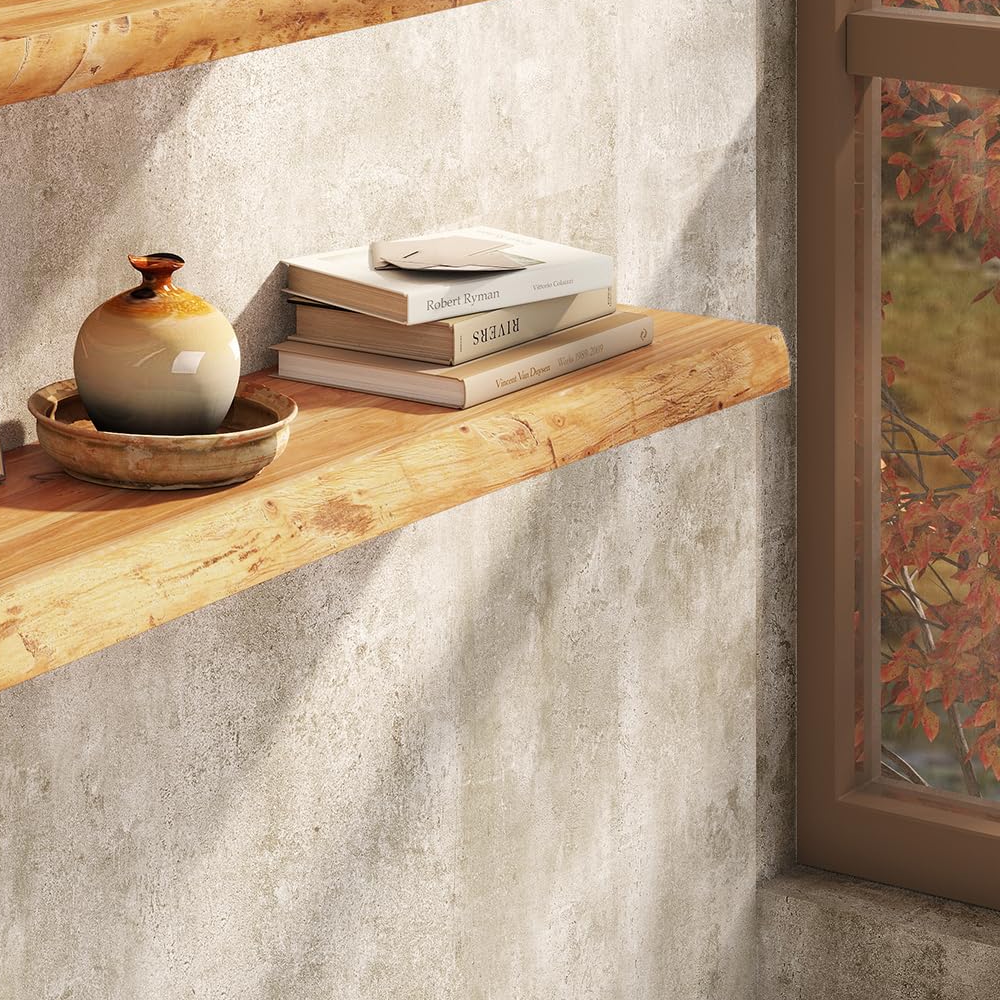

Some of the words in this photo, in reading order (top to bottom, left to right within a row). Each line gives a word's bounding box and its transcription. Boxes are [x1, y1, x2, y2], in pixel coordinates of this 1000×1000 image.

[426, 295, 461, 311] Robert
[463, 290, 501, 306] Ryman
[472, 318, 520, 346] RIVERS
[495, 375, 517, 388] Vincent
[517, 370, 530, 380] Van
